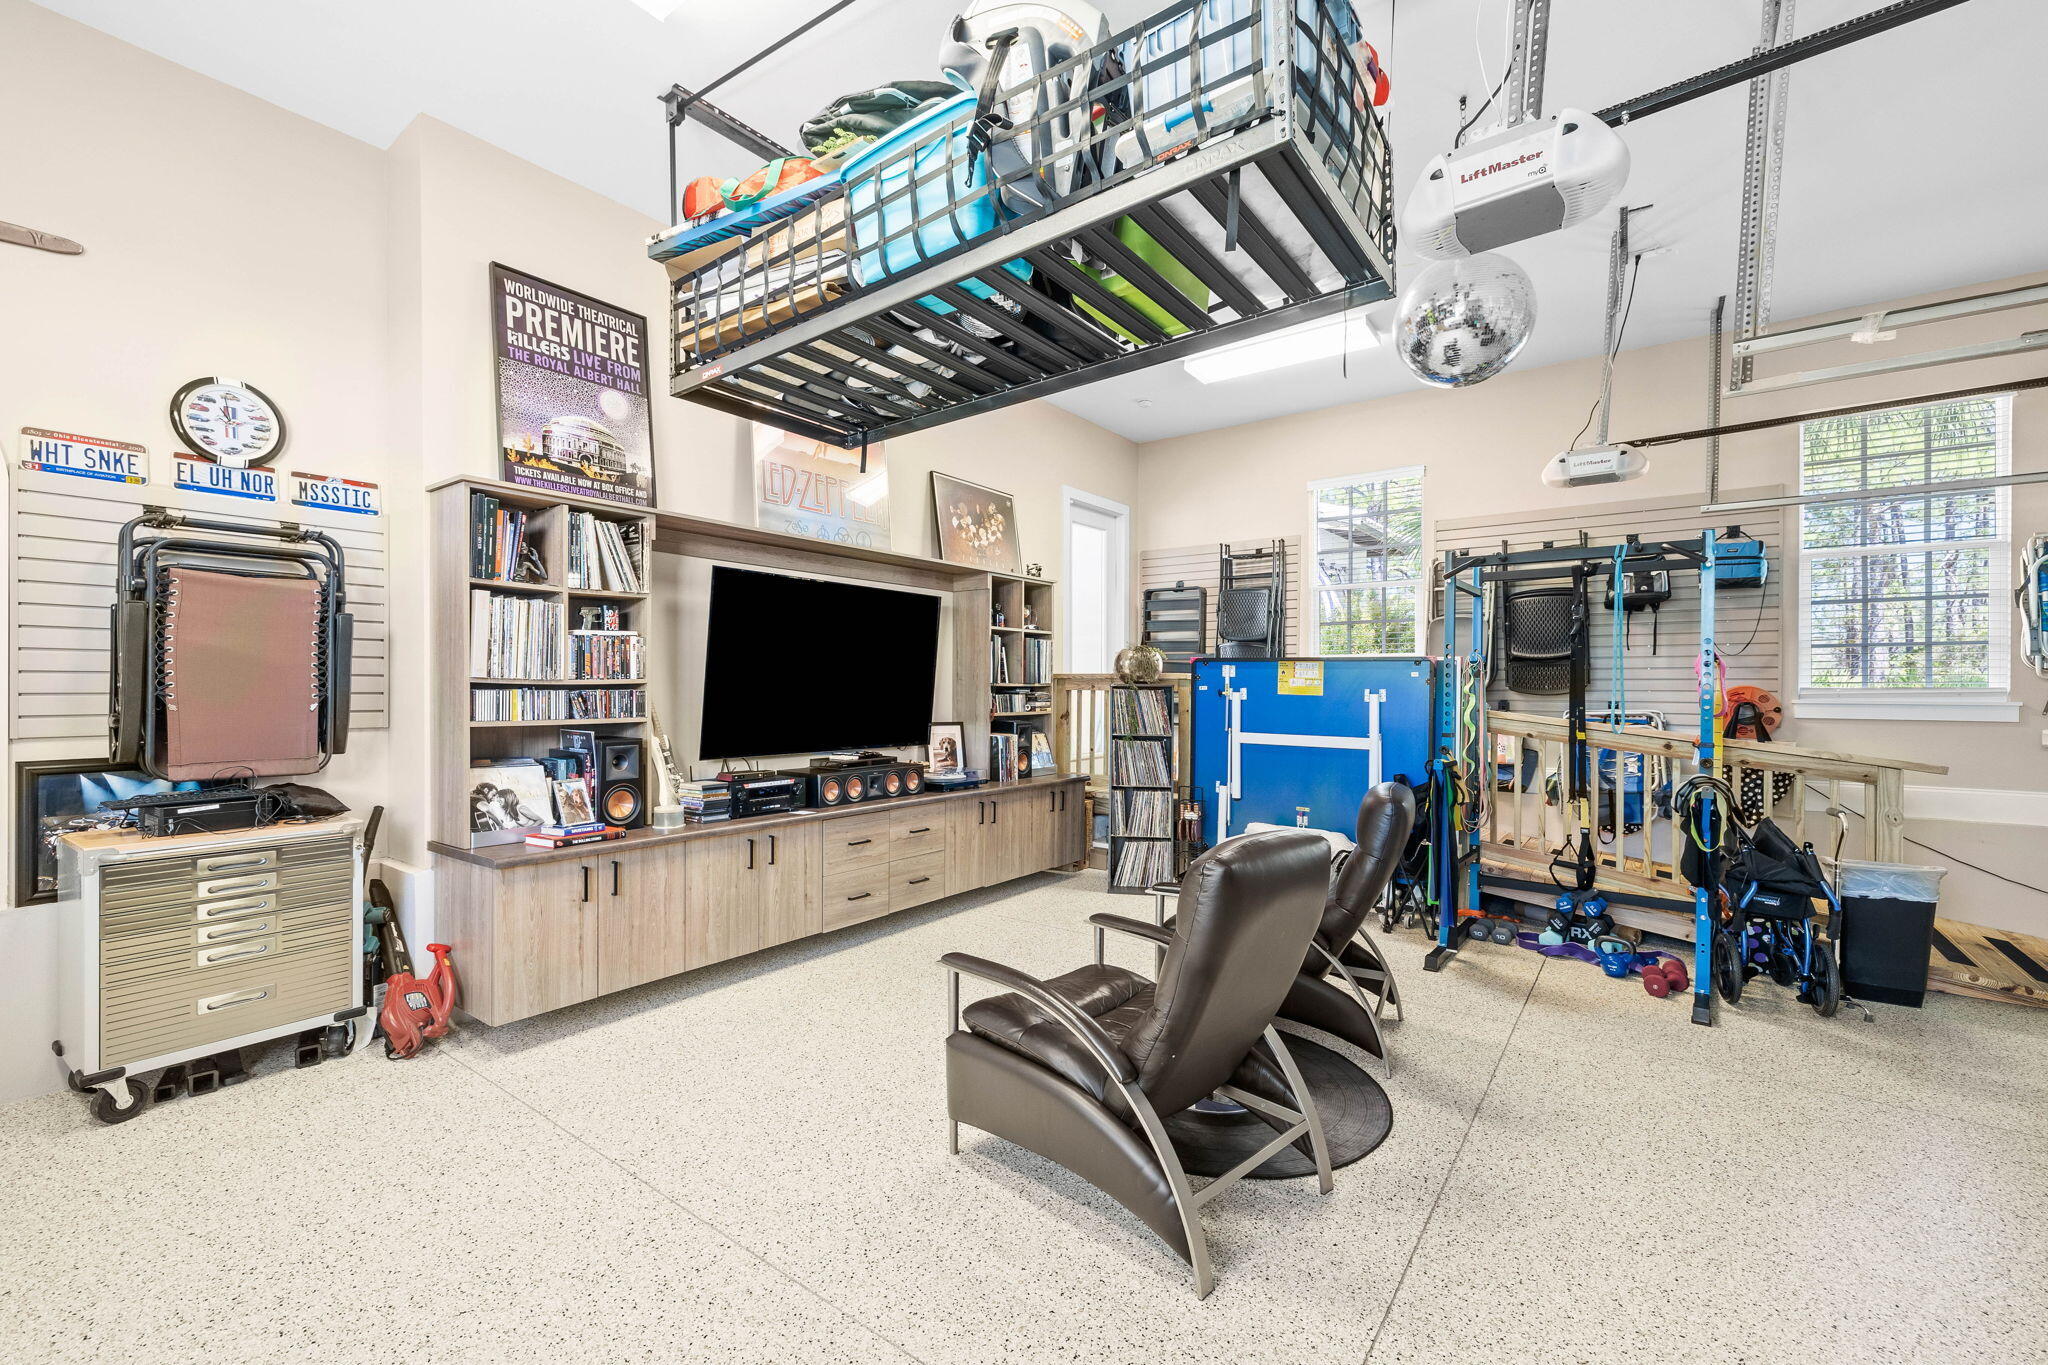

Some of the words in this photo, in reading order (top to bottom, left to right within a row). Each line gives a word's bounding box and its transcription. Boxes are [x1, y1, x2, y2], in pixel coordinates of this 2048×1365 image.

[1157, 140, 1192, 161] ONRAX
[1460, 150, 1543, 184] LiftMaster
[504, 277, 575, 315] WORLDWIDE
[577, 304, 638, 337] THEATRICAL
[505, 294, 640, 368] PREMIERE
[507, 329, 571, 361] KILLERS
[573, 350, 601, 370] LIVE
[607, 360, 641, 382] FROM
[508, 346, 530, 363] THE
[534, 354, 570, 375] ROYAL
[574, 365, 613, 387] ALBERT
[616, 379, 642, 395] HALL
[25, 462, 39, 470] 31
[30, 439, 73, 465] WHT
[84, 447, 139, 475] SNKE
[177, 462, 200, 484] EL
[209, 467, 232, 489] UH
[240, 471, 274, 495] NOR
[299, 481, 371, 509] MSSSTIC
[513, 465, 542, 479] TICKETS
[542, 471, 576, 485] AVAILABLE
[577, 478, 593, 488] NOW
[593, 481, 601, 489] AT
[601, 483, 614, 493] BOX
[615, 485, 634, 496] OFFICE
[635, 490, 647, 498] AND
